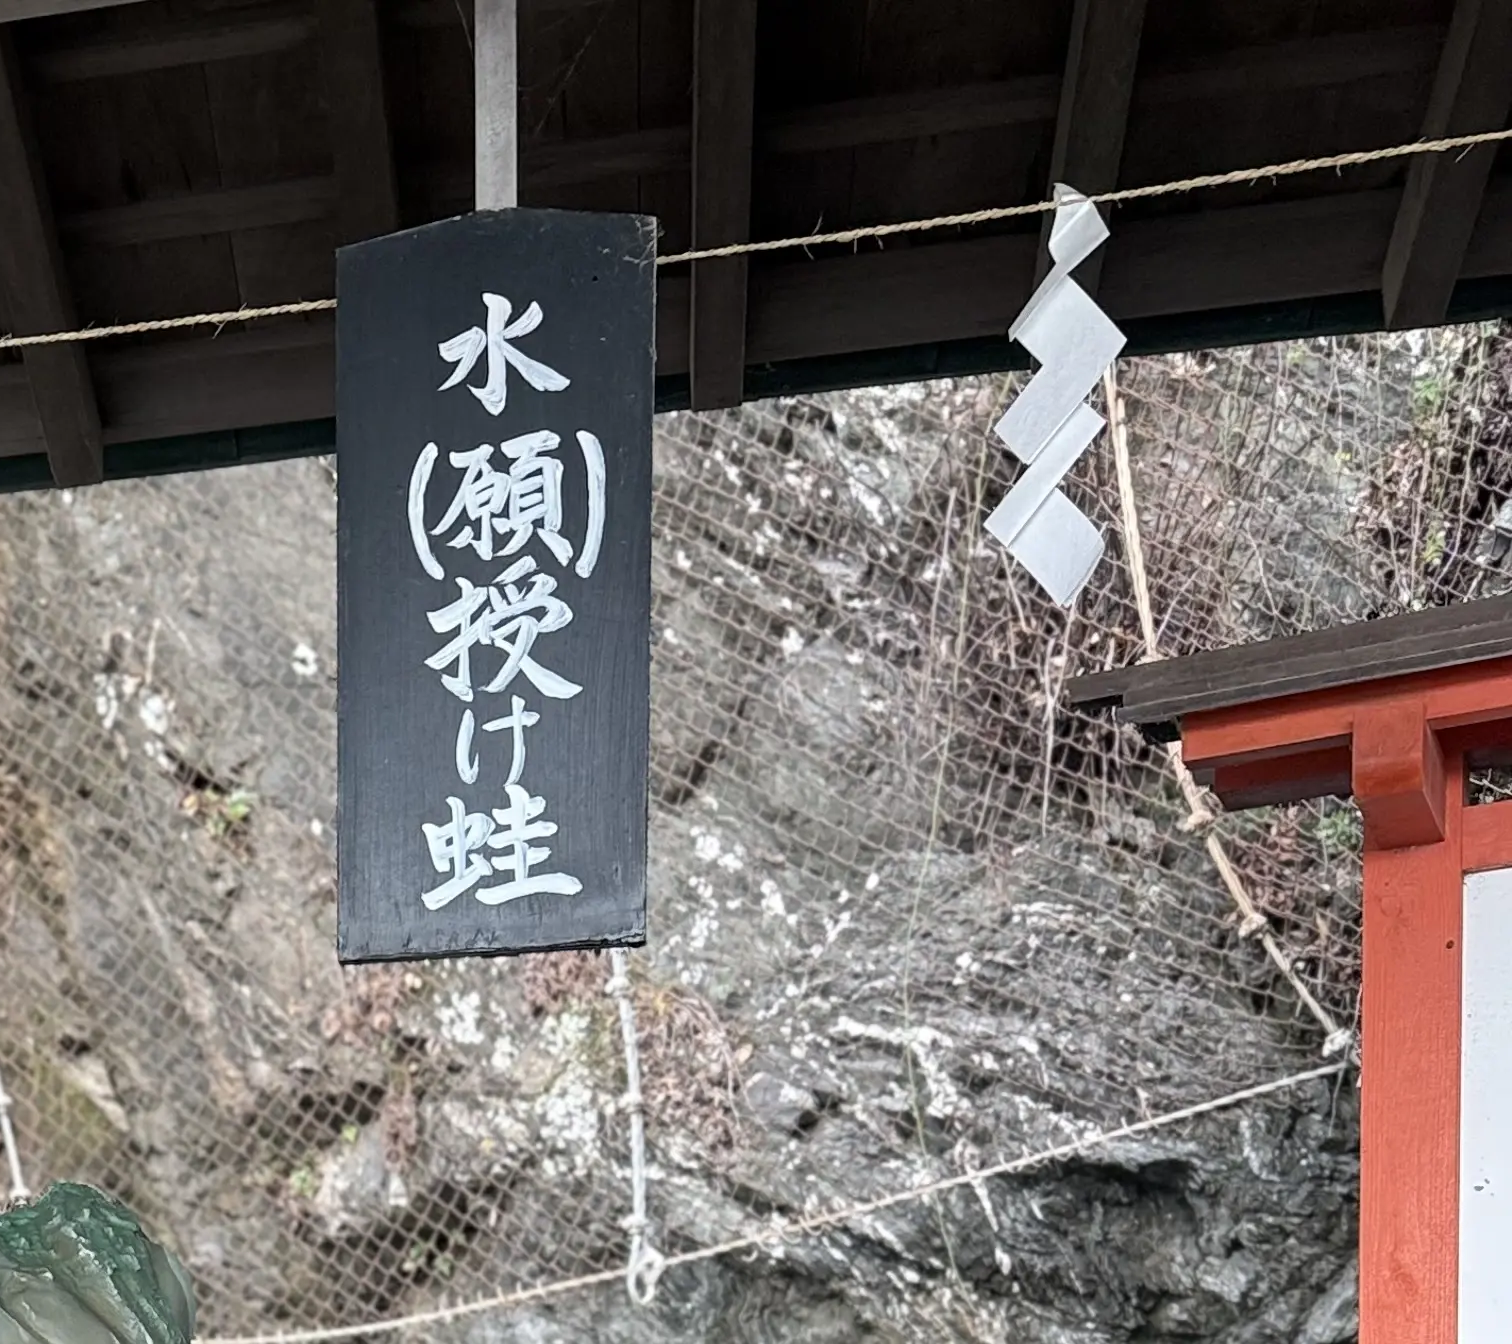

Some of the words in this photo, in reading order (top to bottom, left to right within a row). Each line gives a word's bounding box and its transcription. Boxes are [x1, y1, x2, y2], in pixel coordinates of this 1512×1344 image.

[407, 292, 606, 911] 水(願)授け蛙
